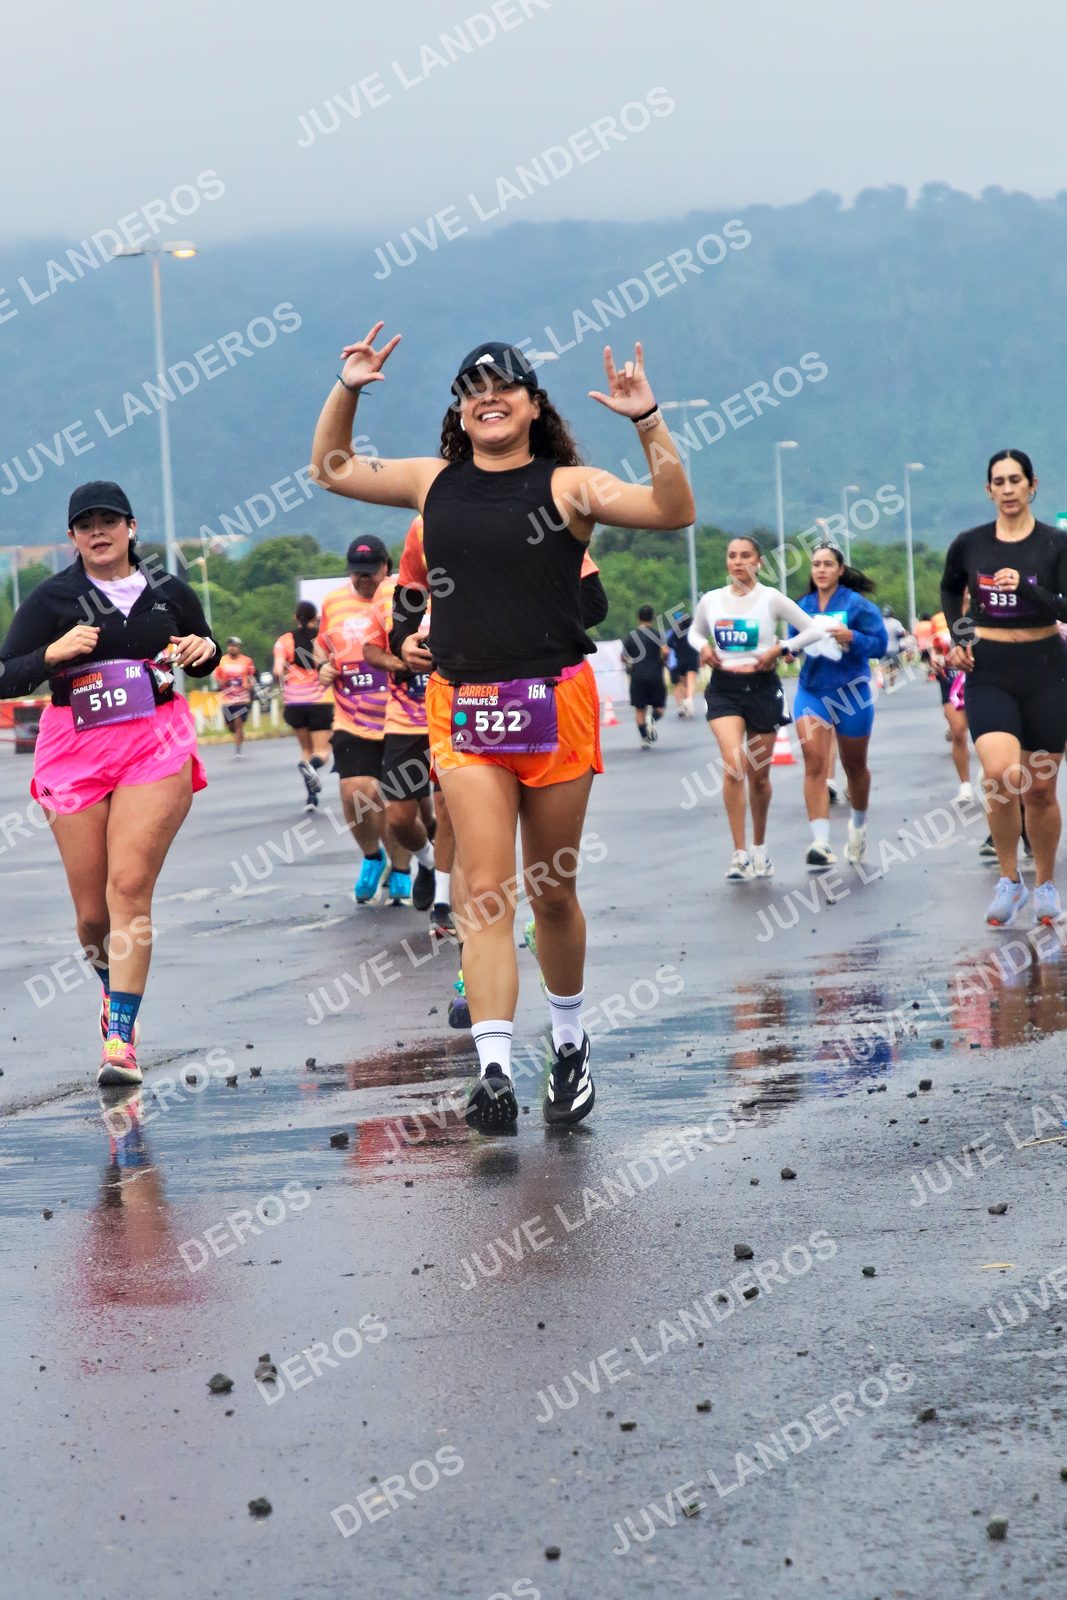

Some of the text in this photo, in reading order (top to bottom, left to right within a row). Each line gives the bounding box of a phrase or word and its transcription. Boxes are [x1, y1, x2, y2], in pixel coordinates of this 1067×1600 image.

[989, 592, 1017, 606] 333
[719, 631, 748, 642] 1170
[125, 666, 142, 679] 16K
[351, 673, 374, 686] 123
[458, 685, 499, 698] CARRERA
[528, 684, 546, 700] 16K
[89, 688, 127, 711] 519
[457, 697, 489, 706] OMNILIFE
[475, 710, 522, 732] 522
